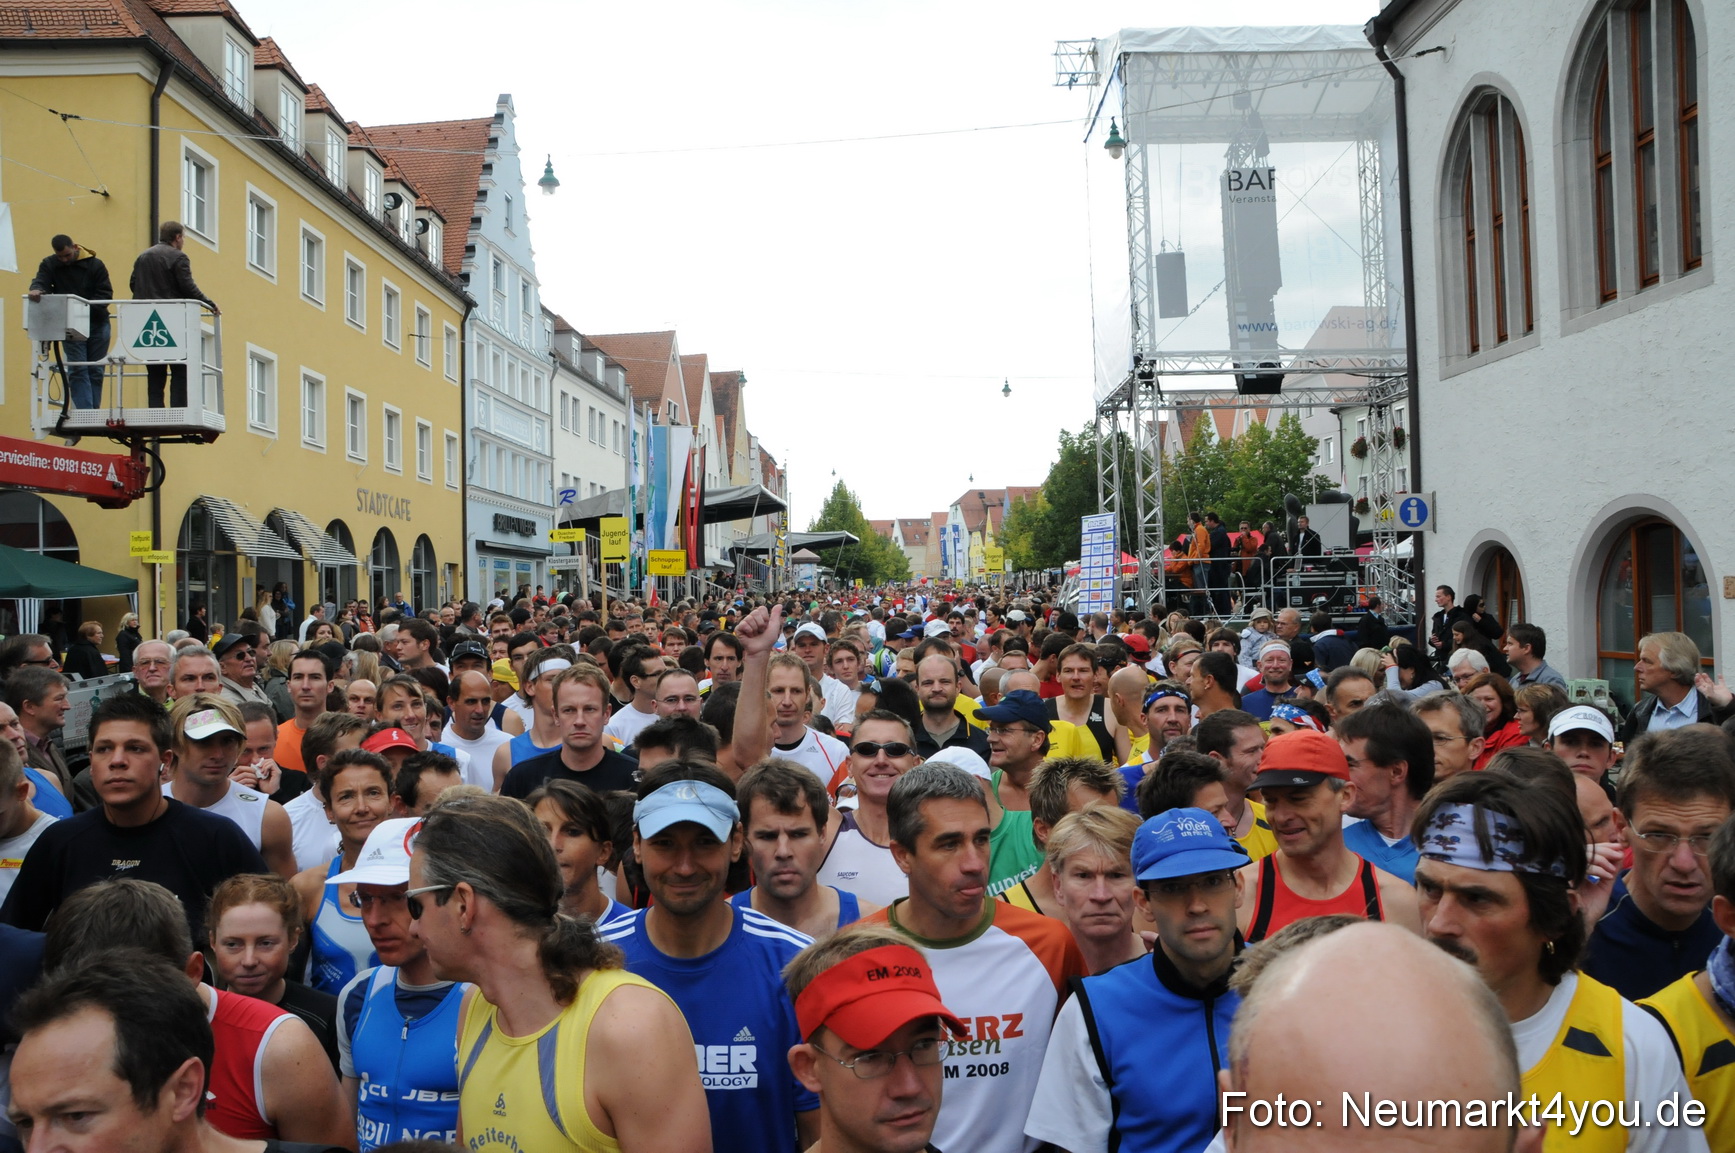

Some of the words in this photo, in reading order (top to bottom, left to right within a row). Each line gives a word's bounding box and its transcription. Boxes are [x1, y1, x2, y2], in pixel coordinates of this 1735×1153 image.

[0, 449, 51, 470] erviceline:
[53, 456, 79, 474] 09181
[80, 461, 103, 478] 6352
[357, 487, 411, 522] STADTCAFE
[602, 529, 628, 538] Jugend-
[609, 538, 622, 546] lauf
[866, 966, 889, 981] EM
[893, 965, 922, 979] 2008
[942, 1013, 1024, 1041] ERZ
[943, 1065, 960, 1079] M
[966, 1061, 1010, 1078] 2008
[700, 1076, 751, 1087] OLOGY
